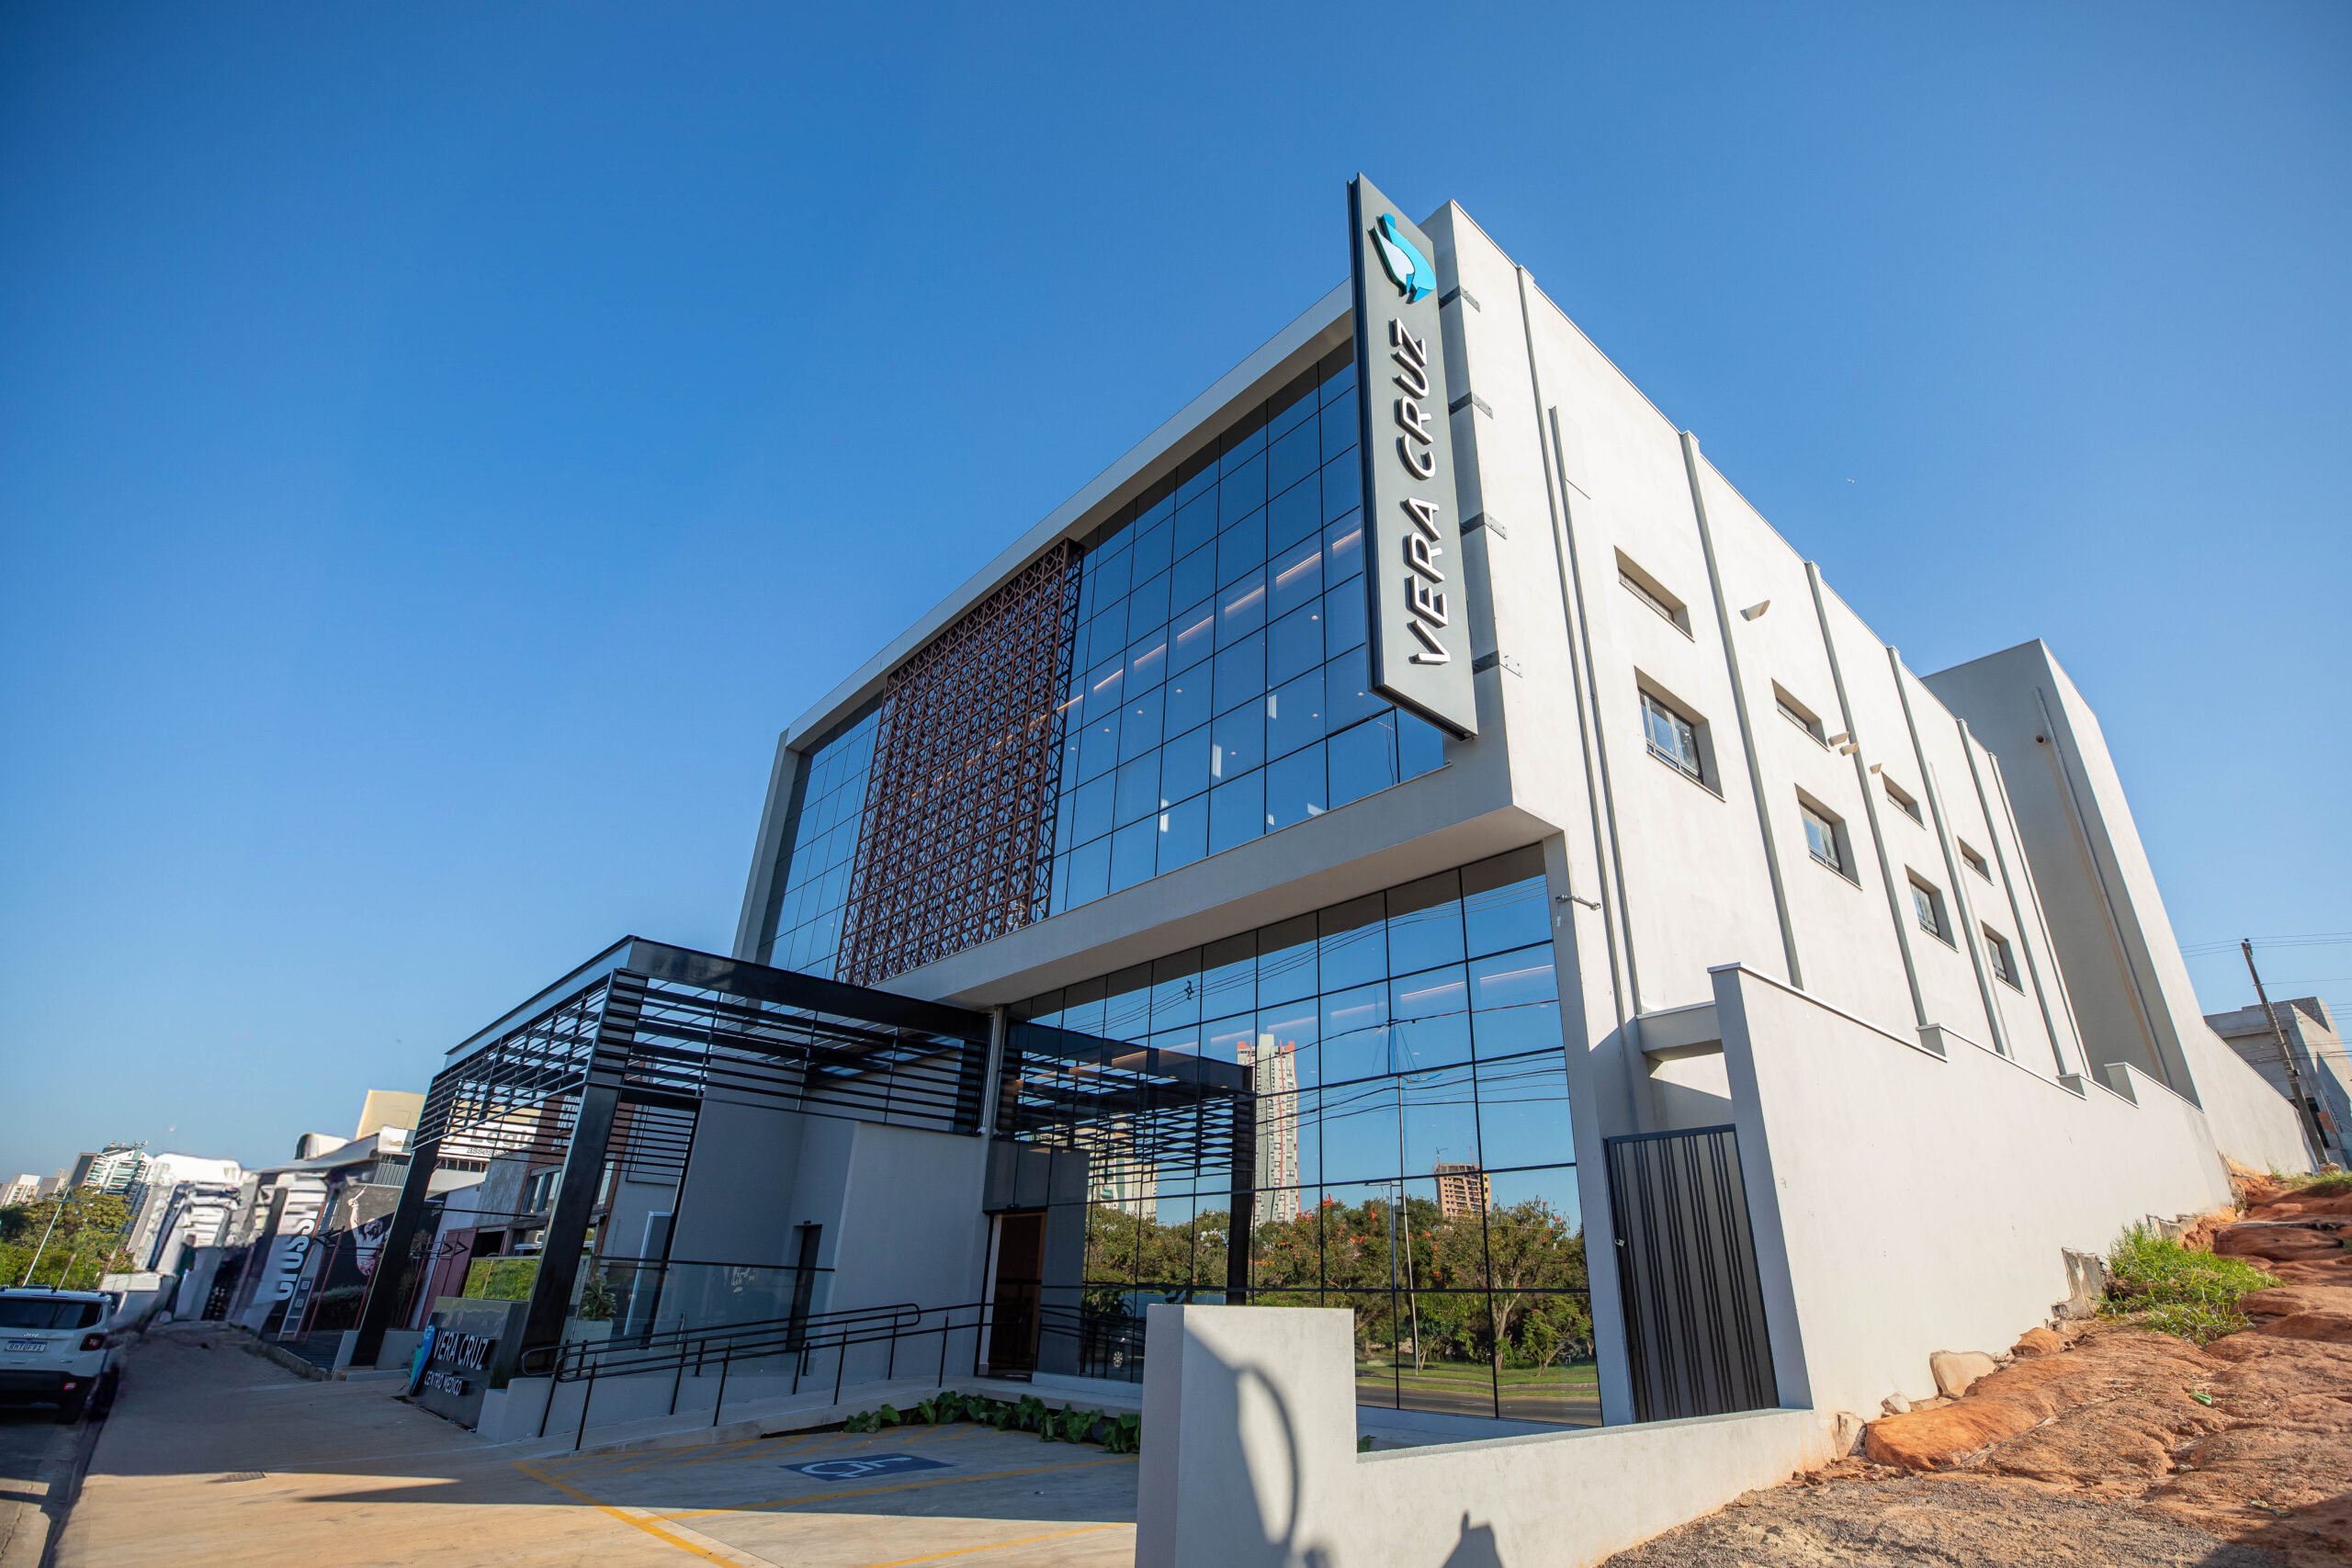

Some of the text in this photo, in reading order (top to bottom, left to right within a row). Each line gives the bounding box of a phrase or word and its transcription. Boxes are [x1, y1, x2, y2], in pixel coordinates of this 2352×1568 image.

[1390, 316, 1452, 665] VERA CRUZ
[434, 1329, 490, 1371] VERA CRUZ
